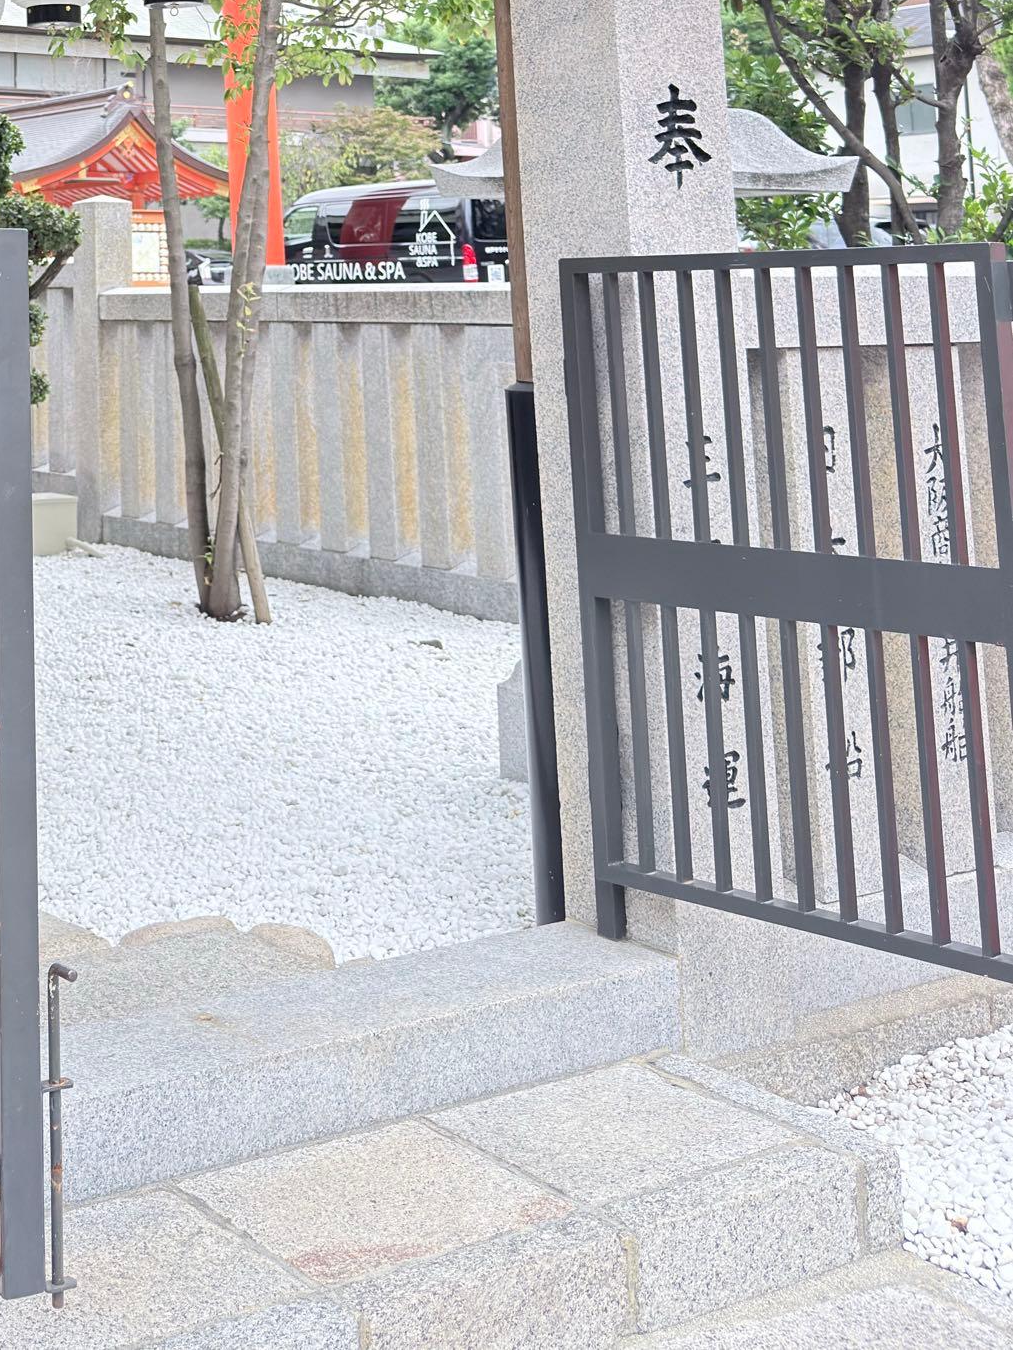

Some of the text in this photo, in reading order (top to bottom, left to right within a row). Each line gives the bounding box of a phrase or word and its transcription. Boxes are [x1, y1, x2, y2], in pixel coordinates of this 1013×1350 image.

[648, 83, 712, 189] 奉
[416, 232, 437, 244] KOBE
[409, 245, 438, 256] SAUNA
[288, 263, 315, 281] OBE
[317, 263, 363, 281] SAUNA
[378, 261, 406, 280] SPA
